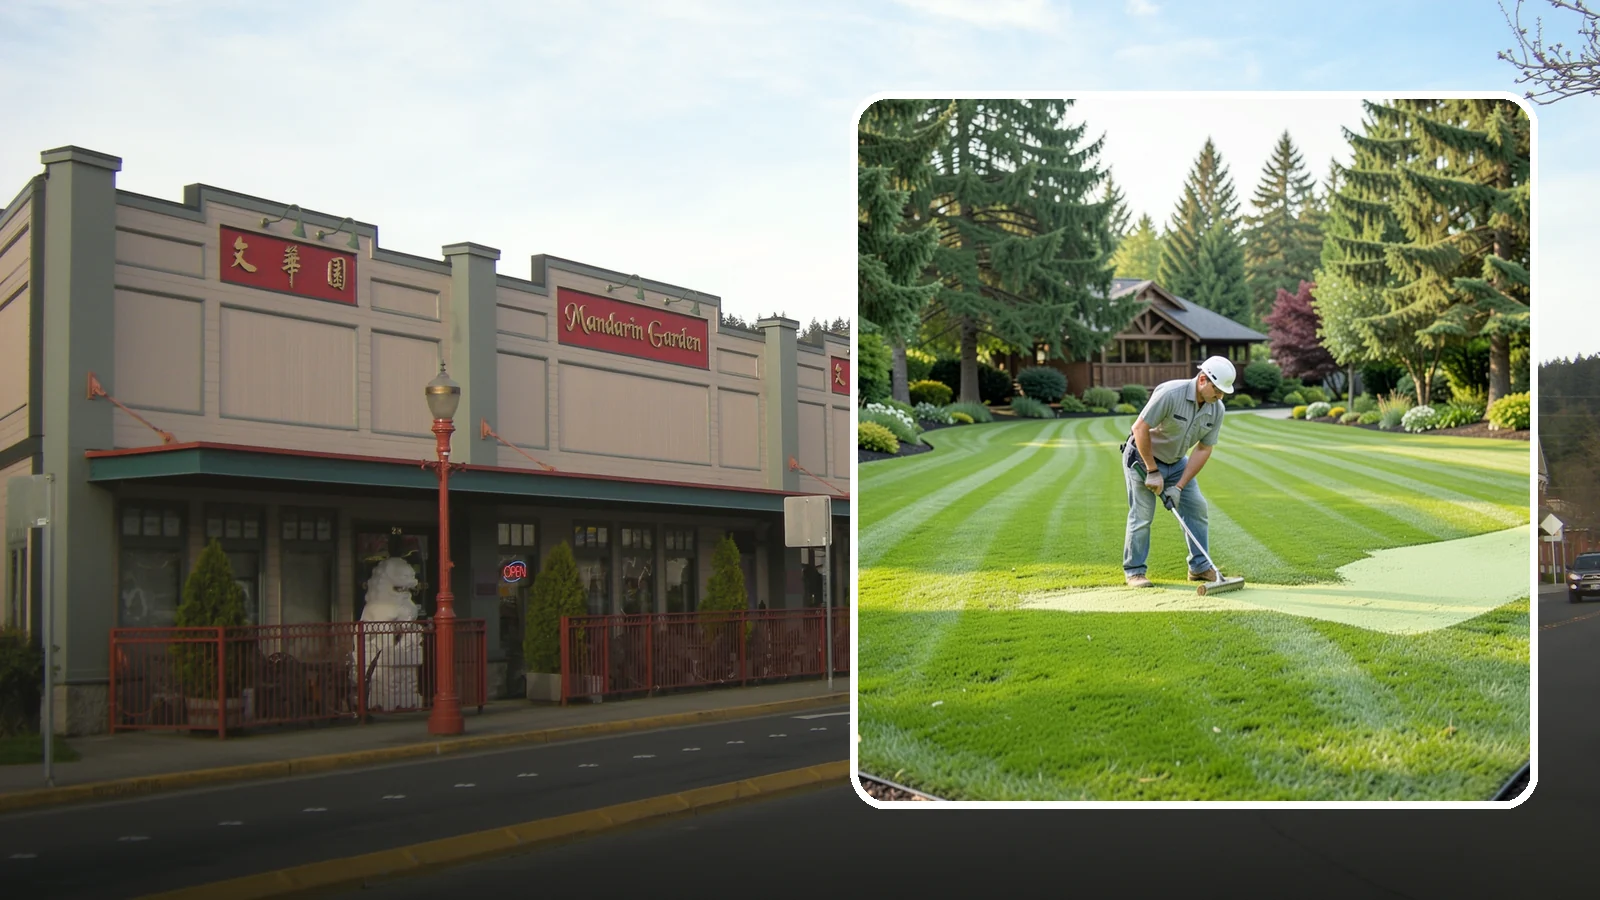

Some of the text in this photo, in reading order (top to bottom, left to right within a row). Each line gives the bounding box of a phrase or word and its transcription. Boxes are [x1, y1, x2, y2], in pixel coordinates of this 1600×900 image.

[564, 302, 701, 352] Mandarin Garden
[503, 565, 527, 578] OPEN
